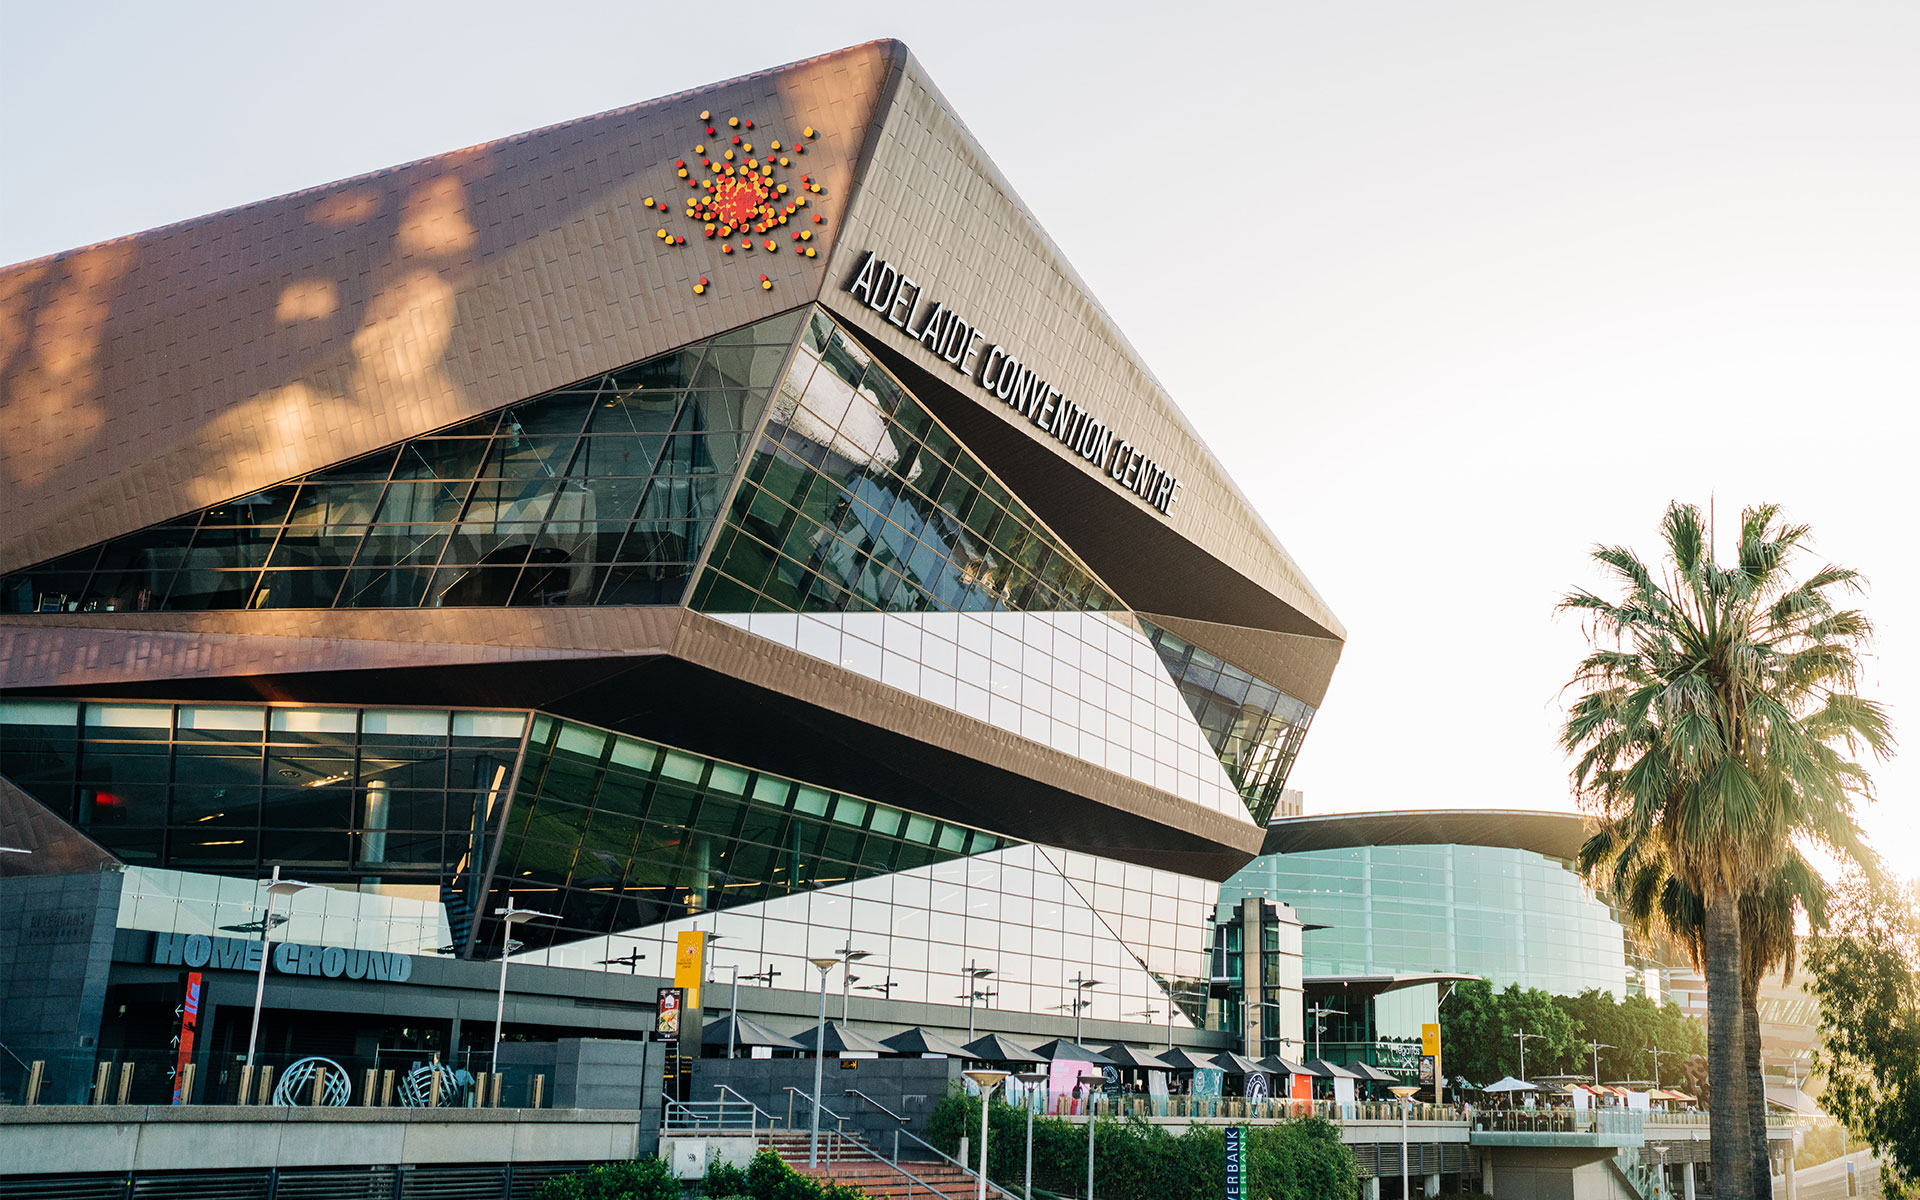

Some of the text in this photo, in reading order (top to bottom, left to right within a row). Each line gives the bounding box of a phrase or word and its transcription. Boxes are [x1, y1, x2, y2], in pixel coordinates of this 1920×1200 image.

[851, 251, 1184, 519] ADELAIDE CONVENTION CENTRE
[154, 931, 413, 982] HOME GROUND
